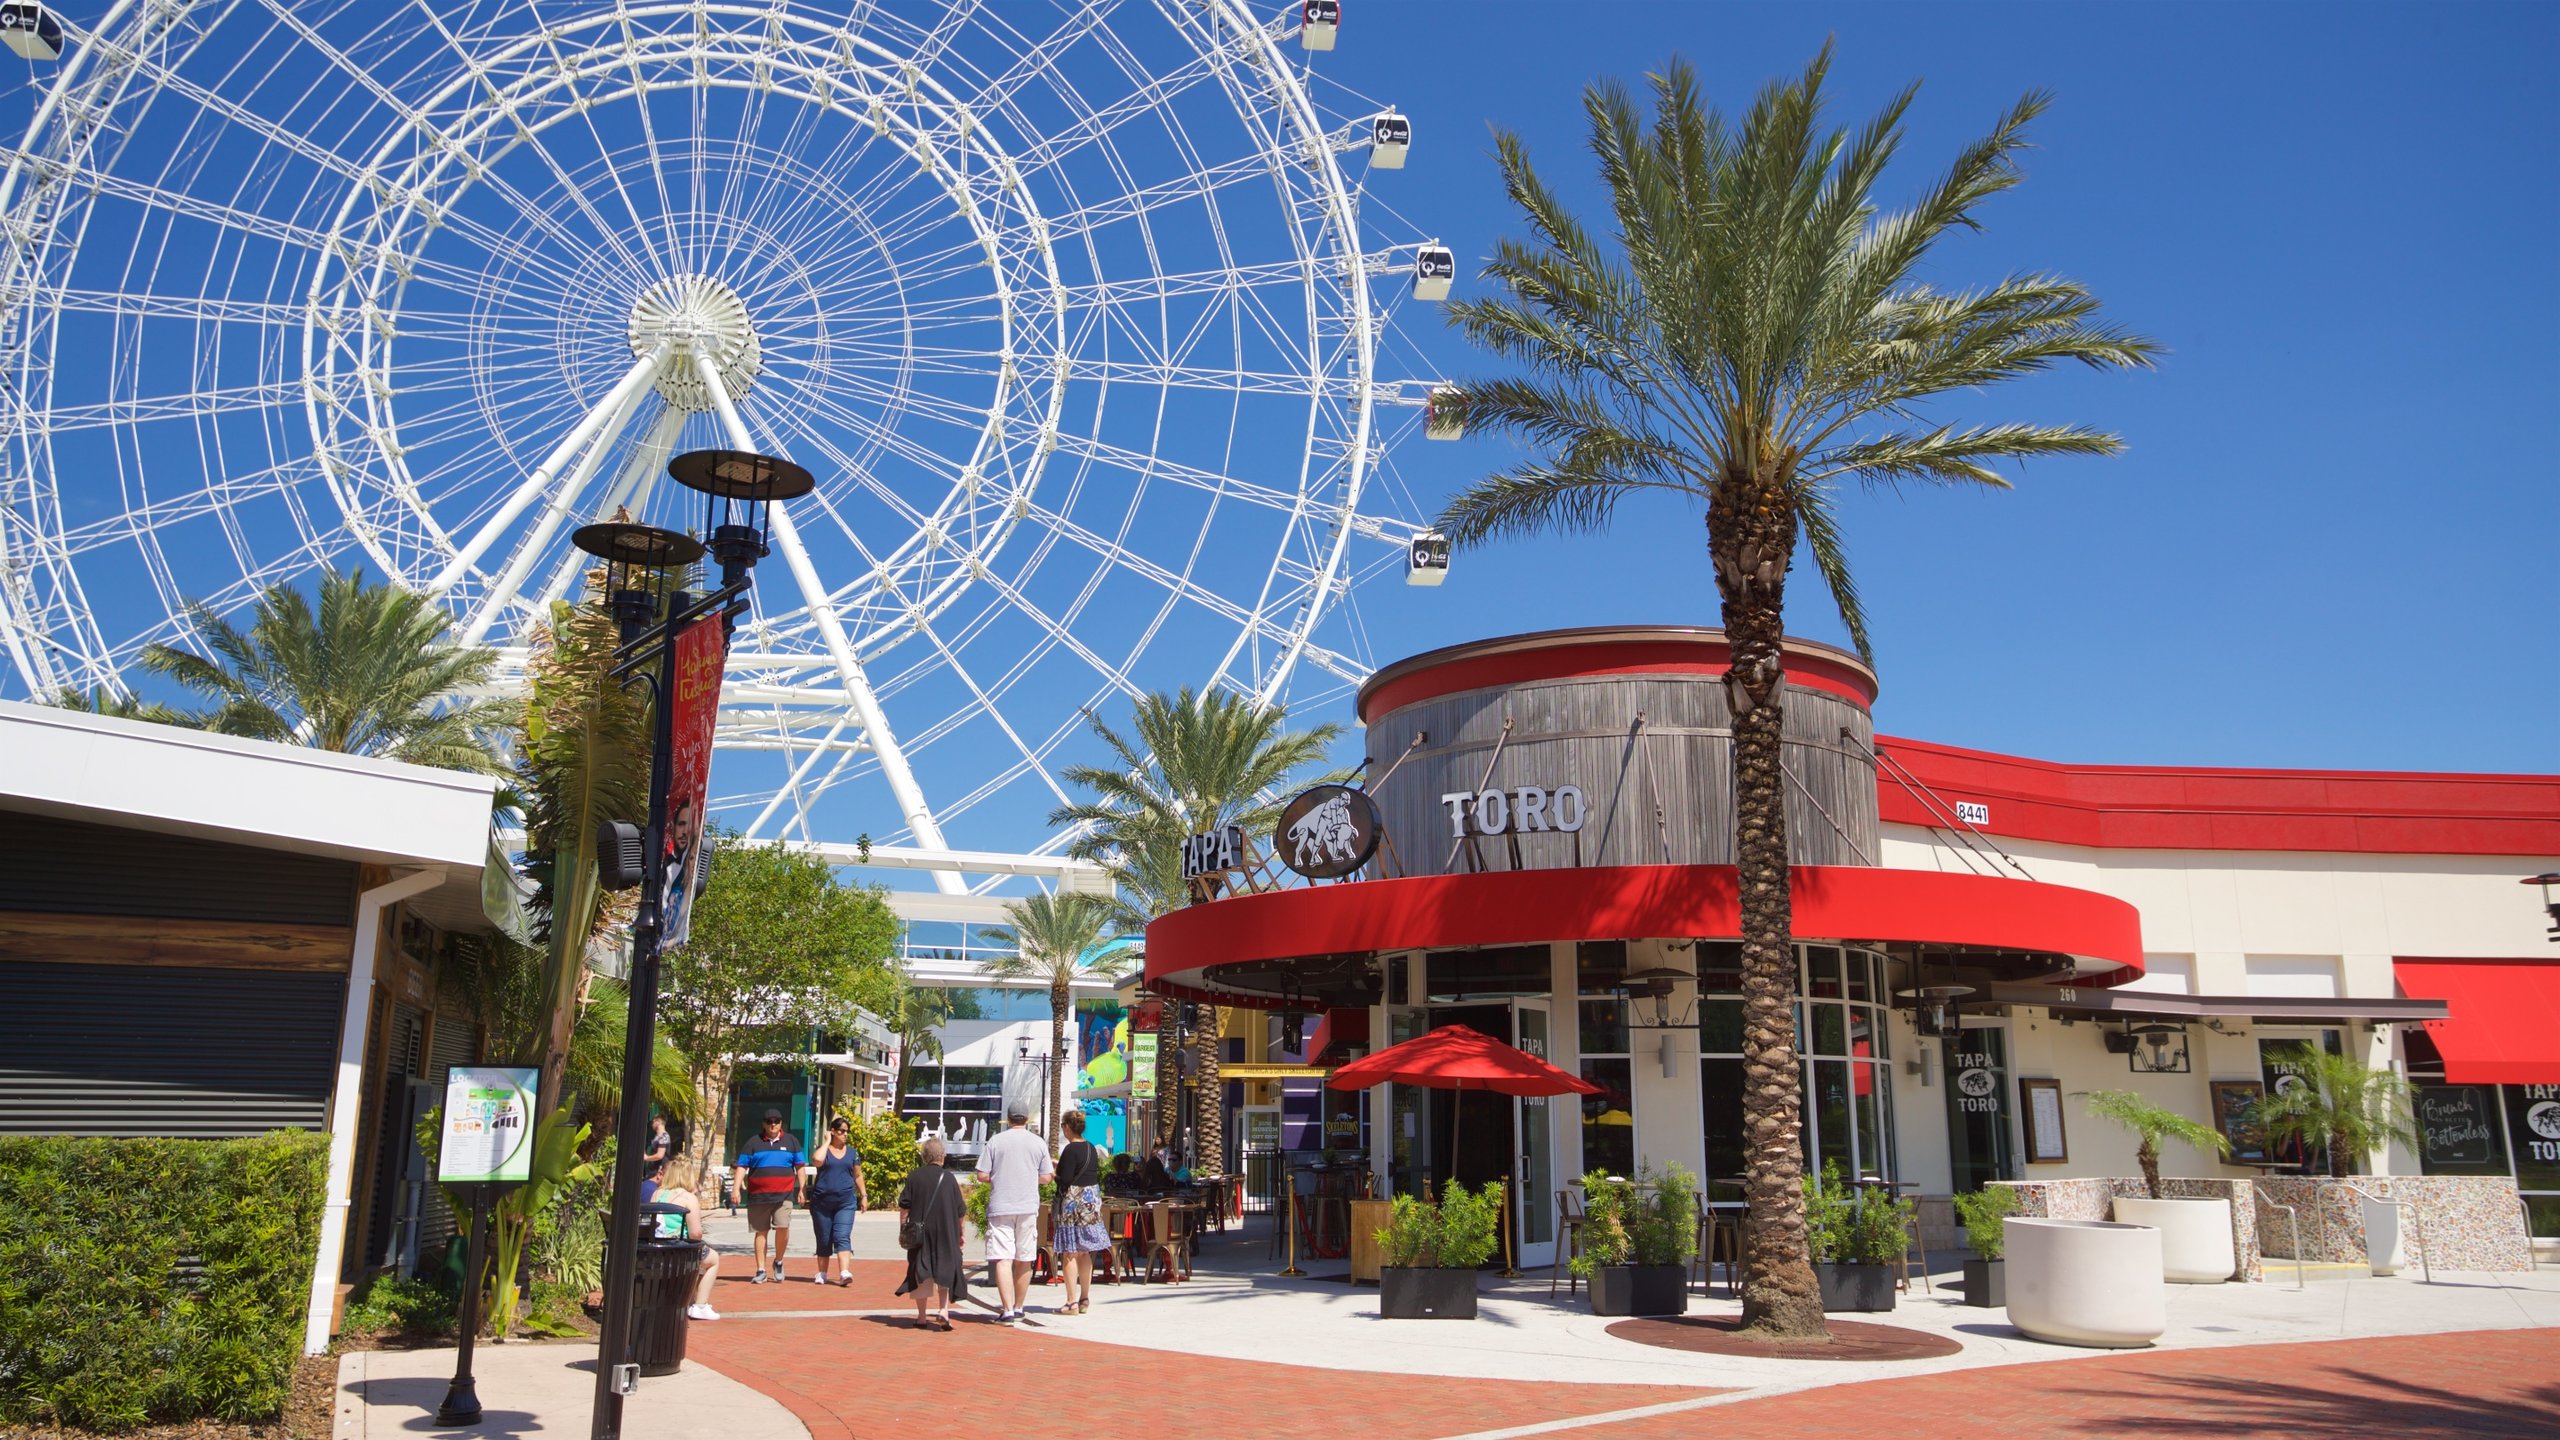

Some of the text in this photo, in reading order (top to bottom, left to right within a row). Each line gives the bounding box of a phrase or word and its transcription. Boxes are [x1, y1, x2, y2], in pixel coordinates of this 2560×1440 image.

[1442, 784, 1587, 838] TORO
[1958, 803, 1988, 822] 8441
[1181, 826, 1235, 879] TAPA
[2060, 988, 2077, 1002] 260
[1522, 1037, 1544, 1055] TAPA
[1955, 1052, 1994, 1068] TAPA
[2525, 1084, 2560, 1099] TAP
[1958, 1097, 1998, 1112] TORO
[2422, 1088, 2474, 1120] Brunch
[2425, 1120, 2490, 1150] Bottomless
